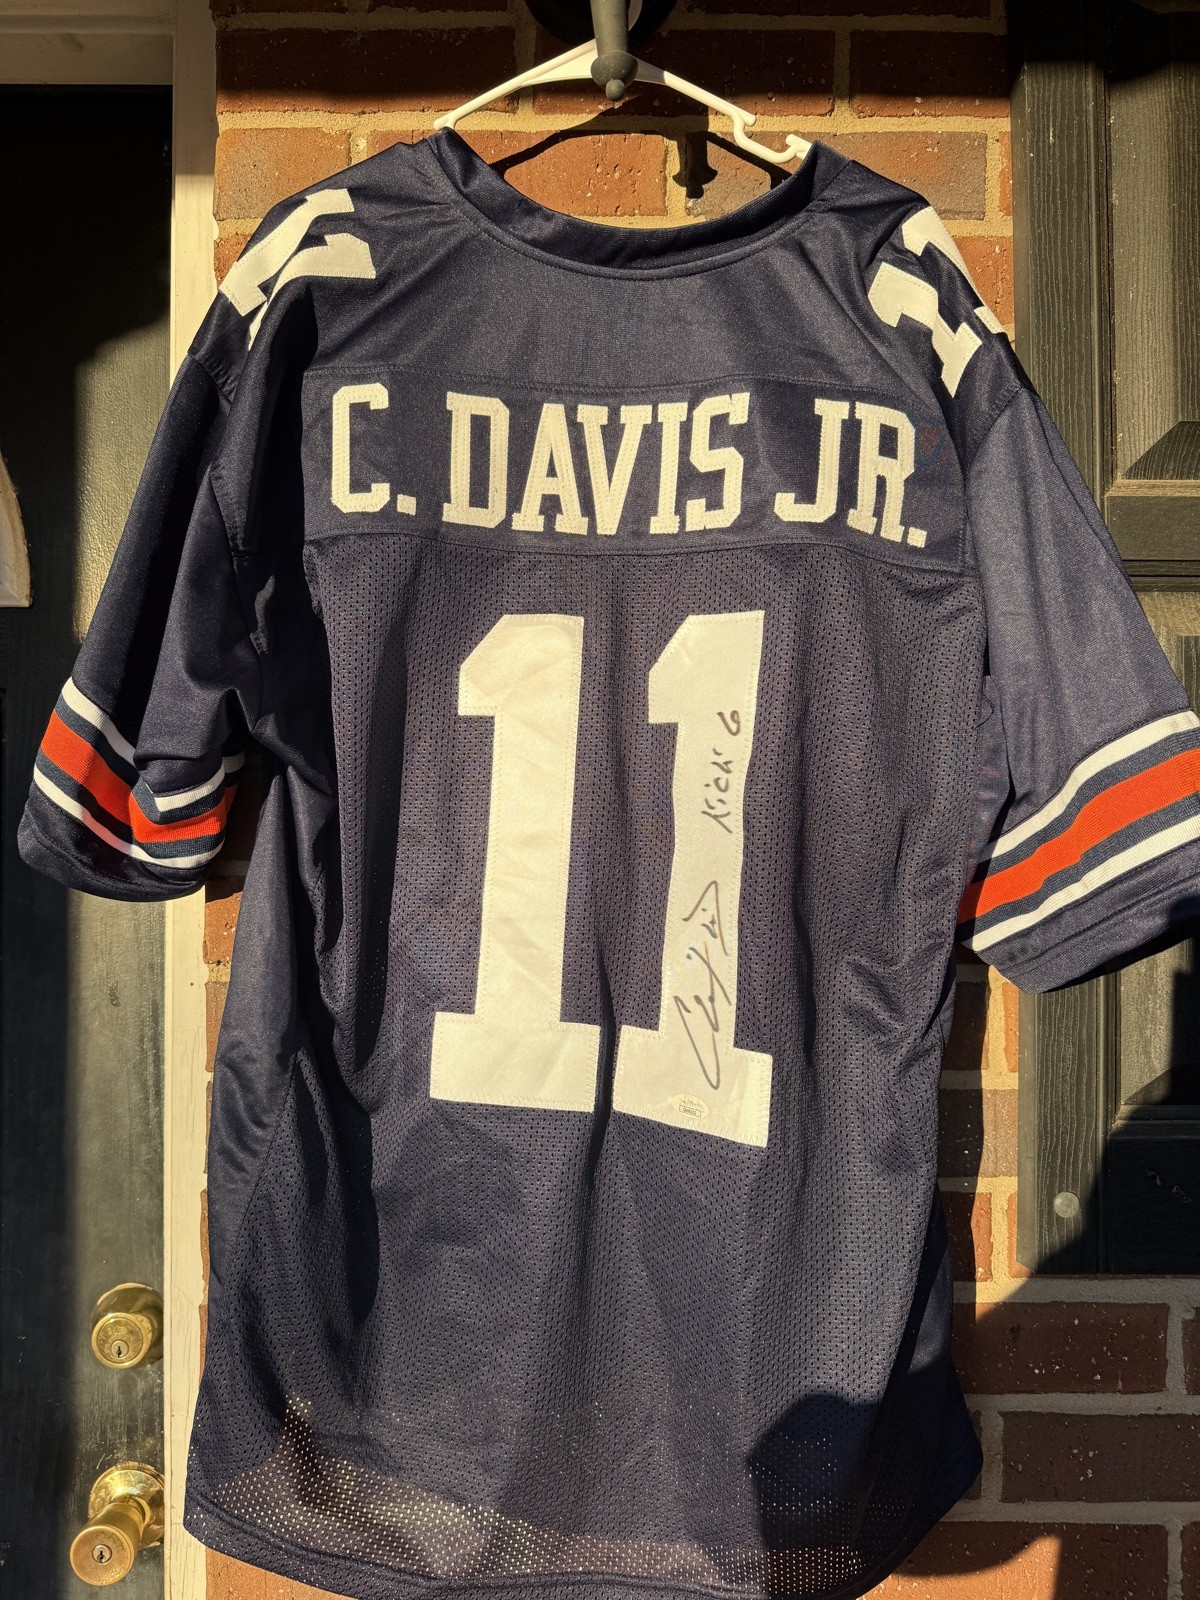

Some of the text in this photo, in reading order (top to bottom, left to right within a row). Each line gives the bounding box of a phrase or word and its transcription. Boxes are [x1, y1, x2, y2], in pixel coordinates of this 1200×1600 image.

[330, 382, 927, 549] C. DAVIS JR.
[717, 710, 741, 736] 6
[430, 610, 773, 1148] 11
